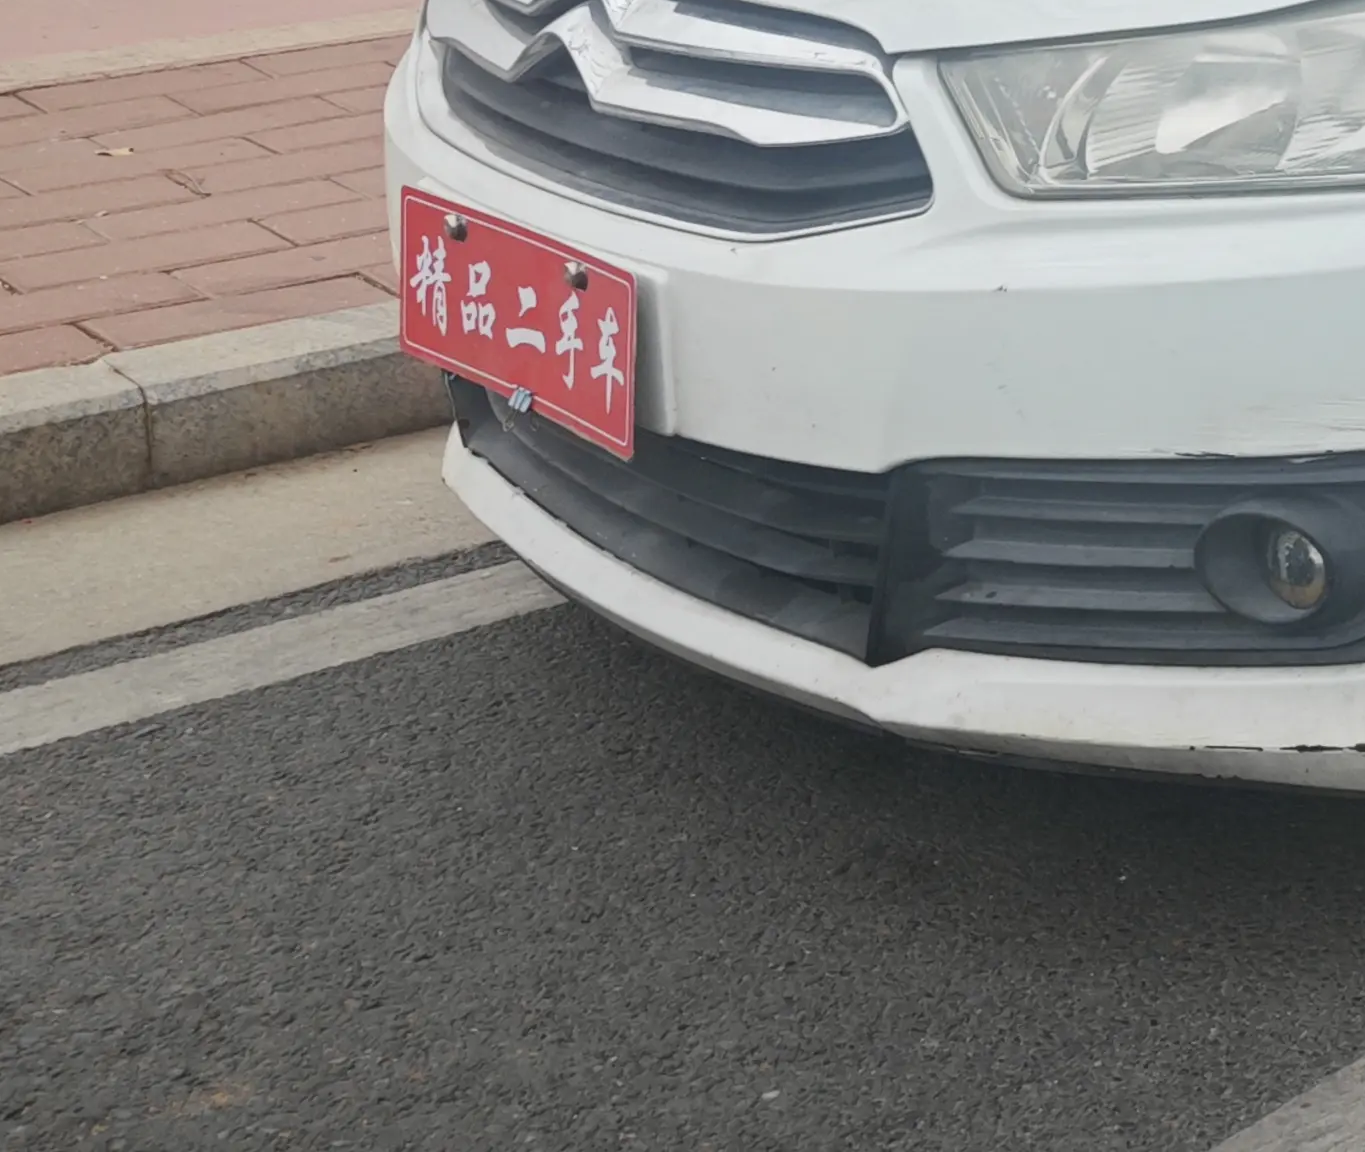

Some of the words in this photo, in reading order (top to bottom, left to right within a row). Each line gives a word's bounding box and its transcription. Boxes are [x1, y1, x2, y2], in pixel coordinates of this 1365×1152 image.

[410, 235, 625, 416] 精品二手车
